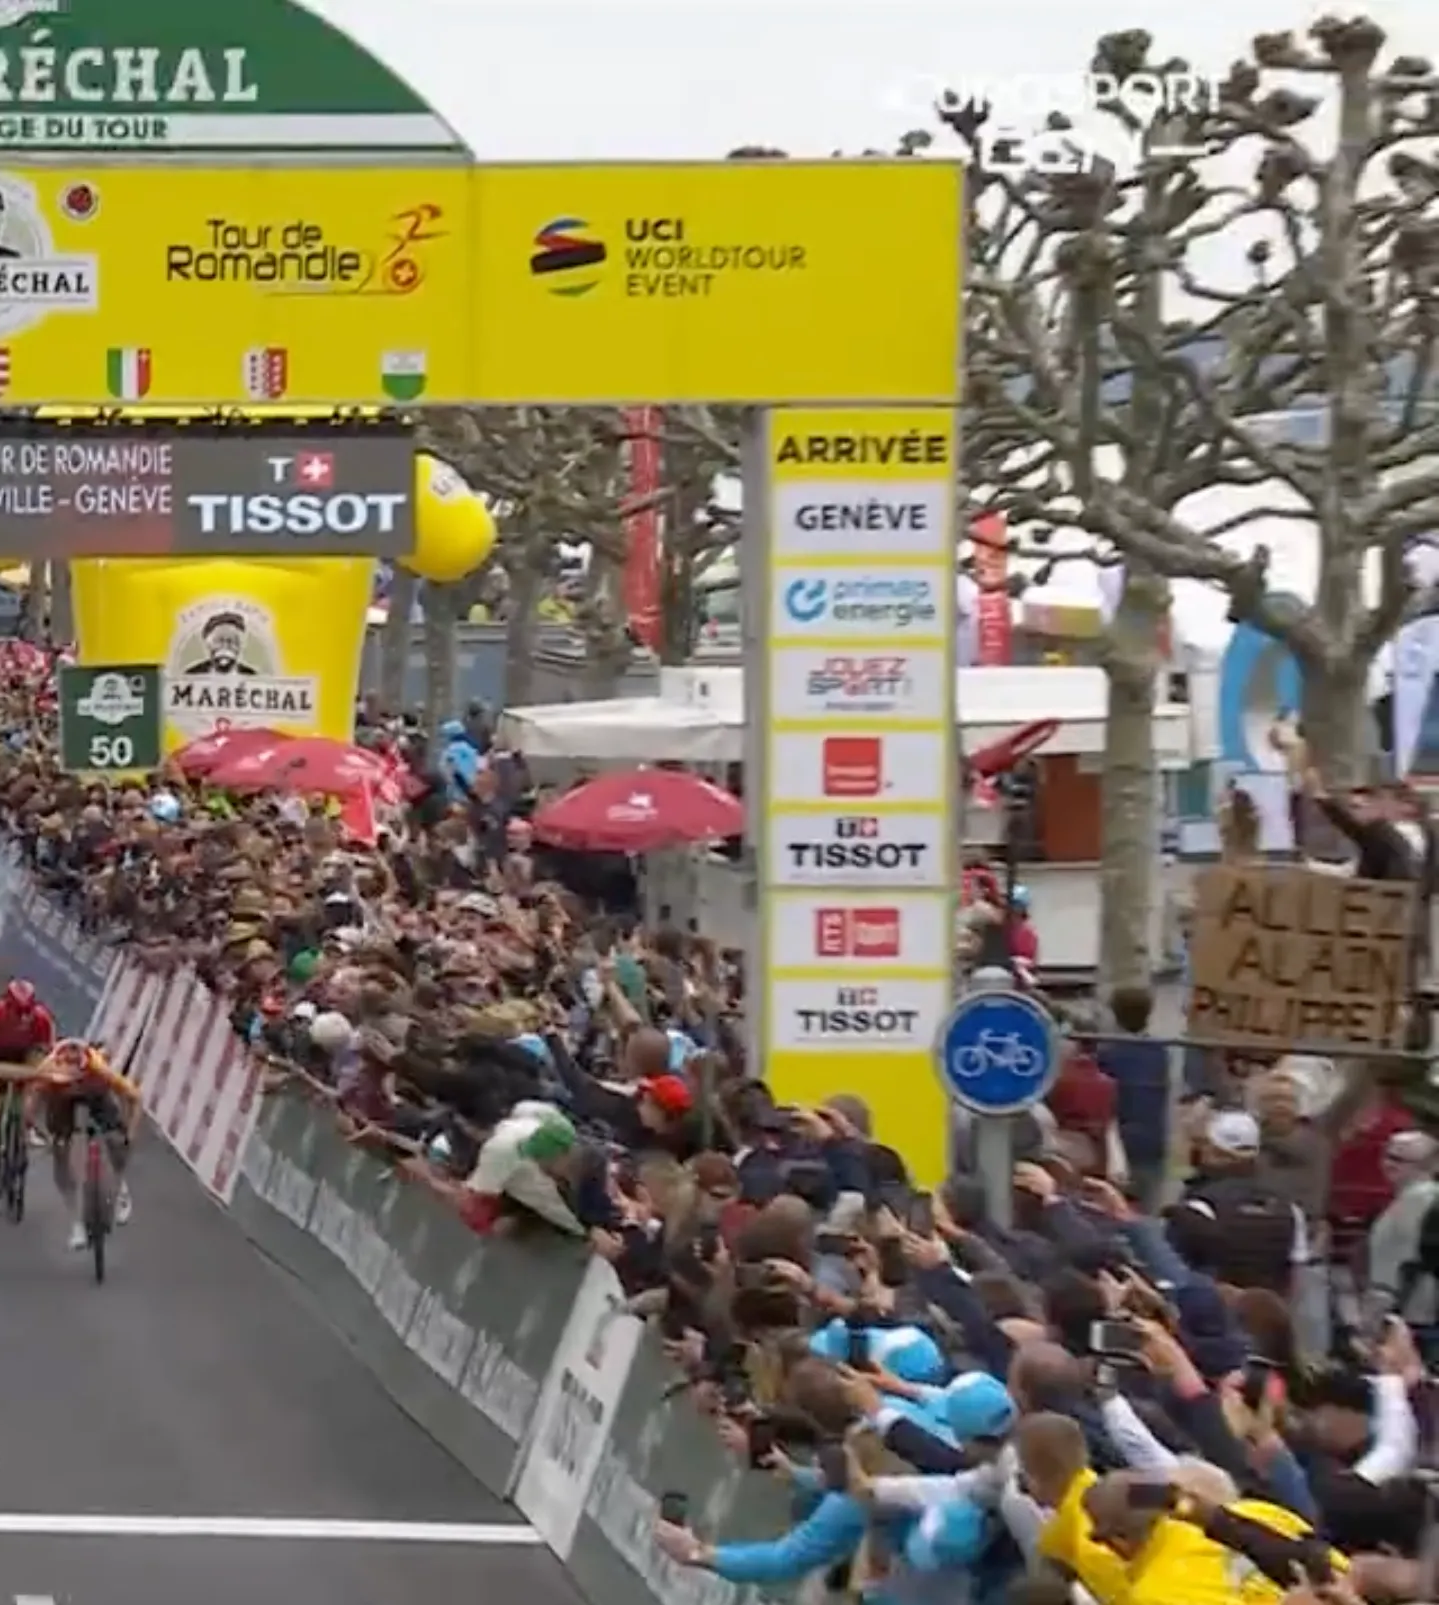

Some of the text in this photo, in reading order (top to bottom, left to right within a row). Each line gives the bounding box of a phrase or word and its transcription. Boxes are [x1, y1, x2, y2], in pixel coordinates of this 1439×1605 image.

[45, 117, 85, 139] DU
[93, 117, 168, 139] TOUR
[206, 218, 322, 250] Tour de
[625, 218, 684, 242] UCI
[625, 246, 806, 271] WORLDTOUR
[625, 273, 715, 297] EVENT
[21, 444, 48, 473] DE
[54, 444, 173, 474] ROMANDIE
[776, 429, 949, 465] ARRIVÉE
[74, 476, 173, 515] GENÈVE
[187, 493, 407, 534] TISSOT
[795, 498, 928, 531] GENÈVE
[170, 681, 313, 711] MARÉCHAL
[89, 736, 133, 767] 50
[788, 843, 928, 868] TISSOT
[1220, 879, 1406, 940] ALLEZ
[1228, 936, 1401, 996] ALAIN
[795, 1009, 919, 1033] TISSOT
